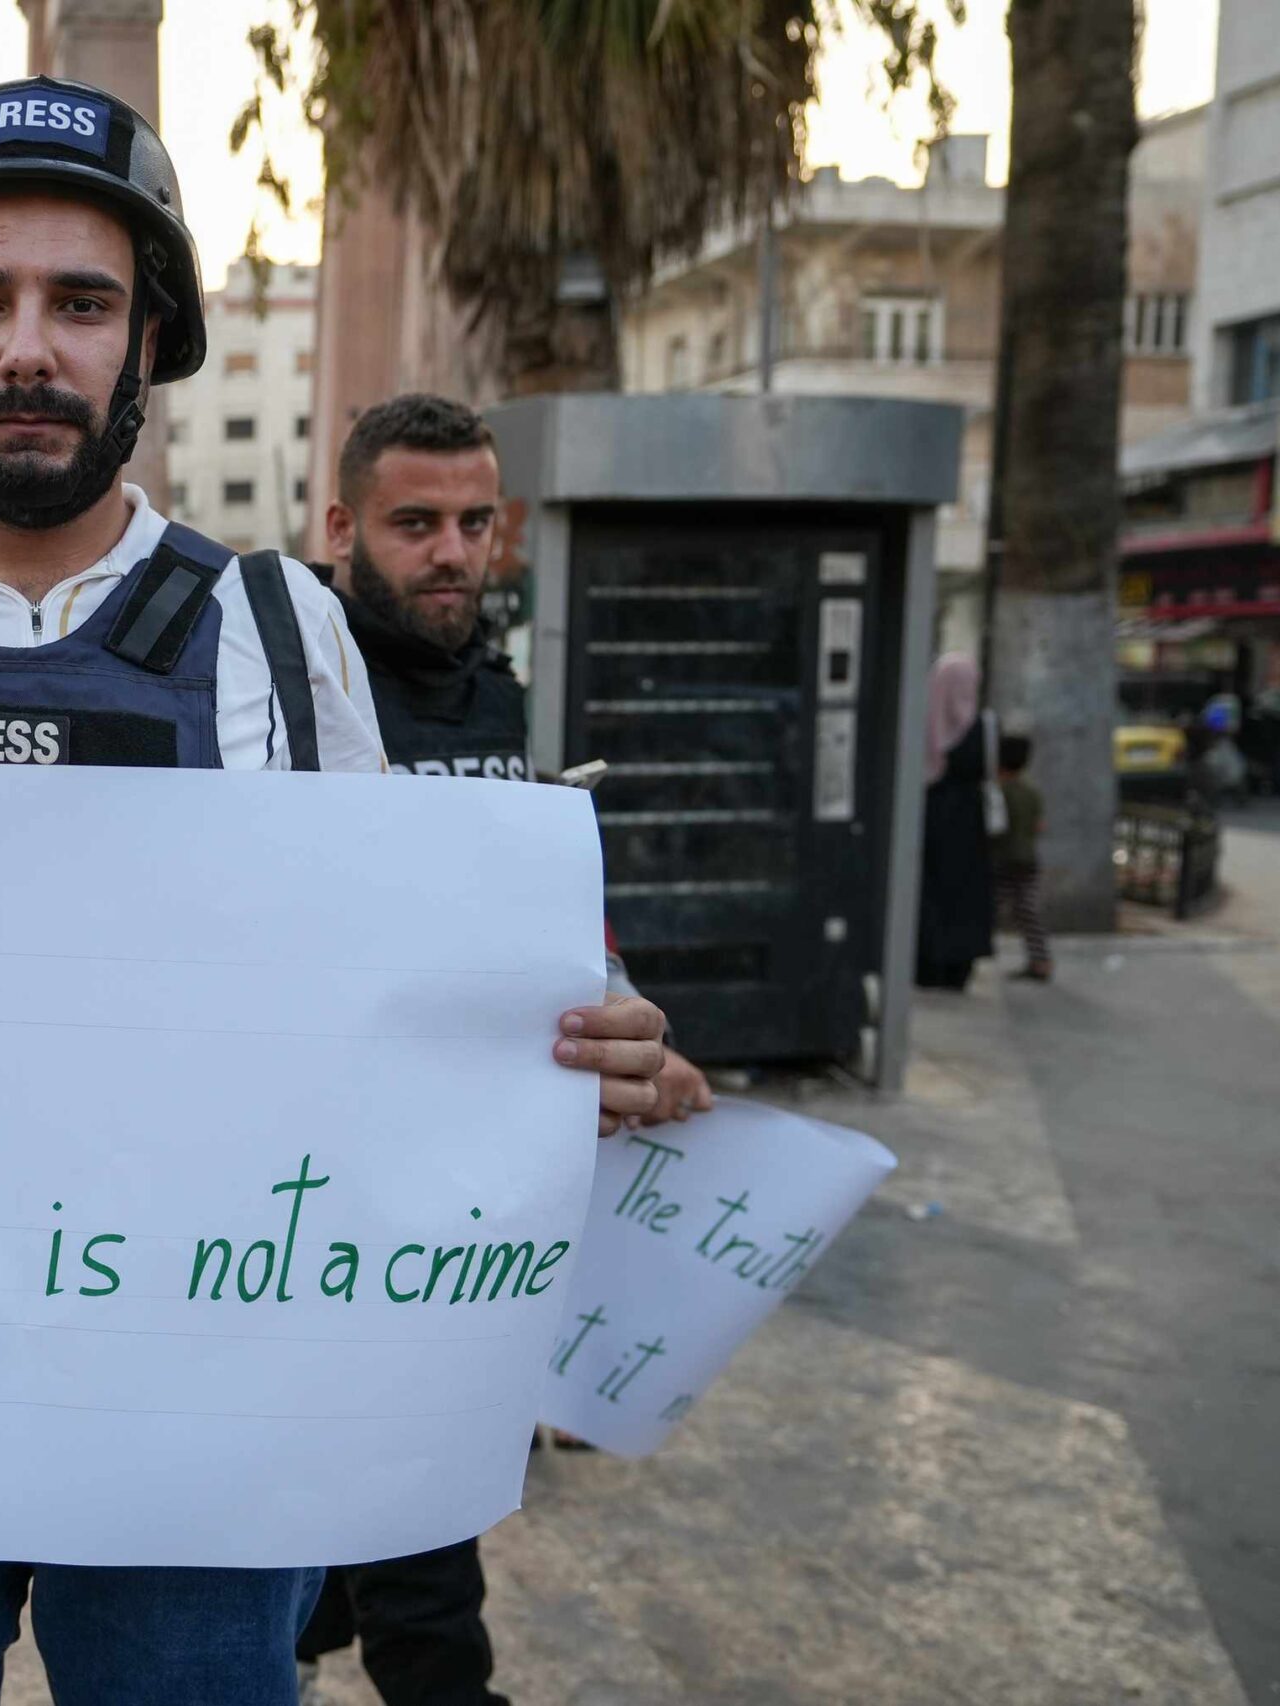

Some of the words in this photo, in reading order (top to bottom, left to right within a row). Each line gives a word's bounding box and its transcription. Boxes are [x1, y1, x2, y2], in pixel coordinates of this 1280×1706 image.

[46, 1201, 127, 1297] is
[188, 1154, 331, 1303] not
[320, 1241, 360, 1303] a
[384, 1206, 572, 1305] crime
[615, 1135, 685, 1234] The
[597, 1336, 667, 1402] it
